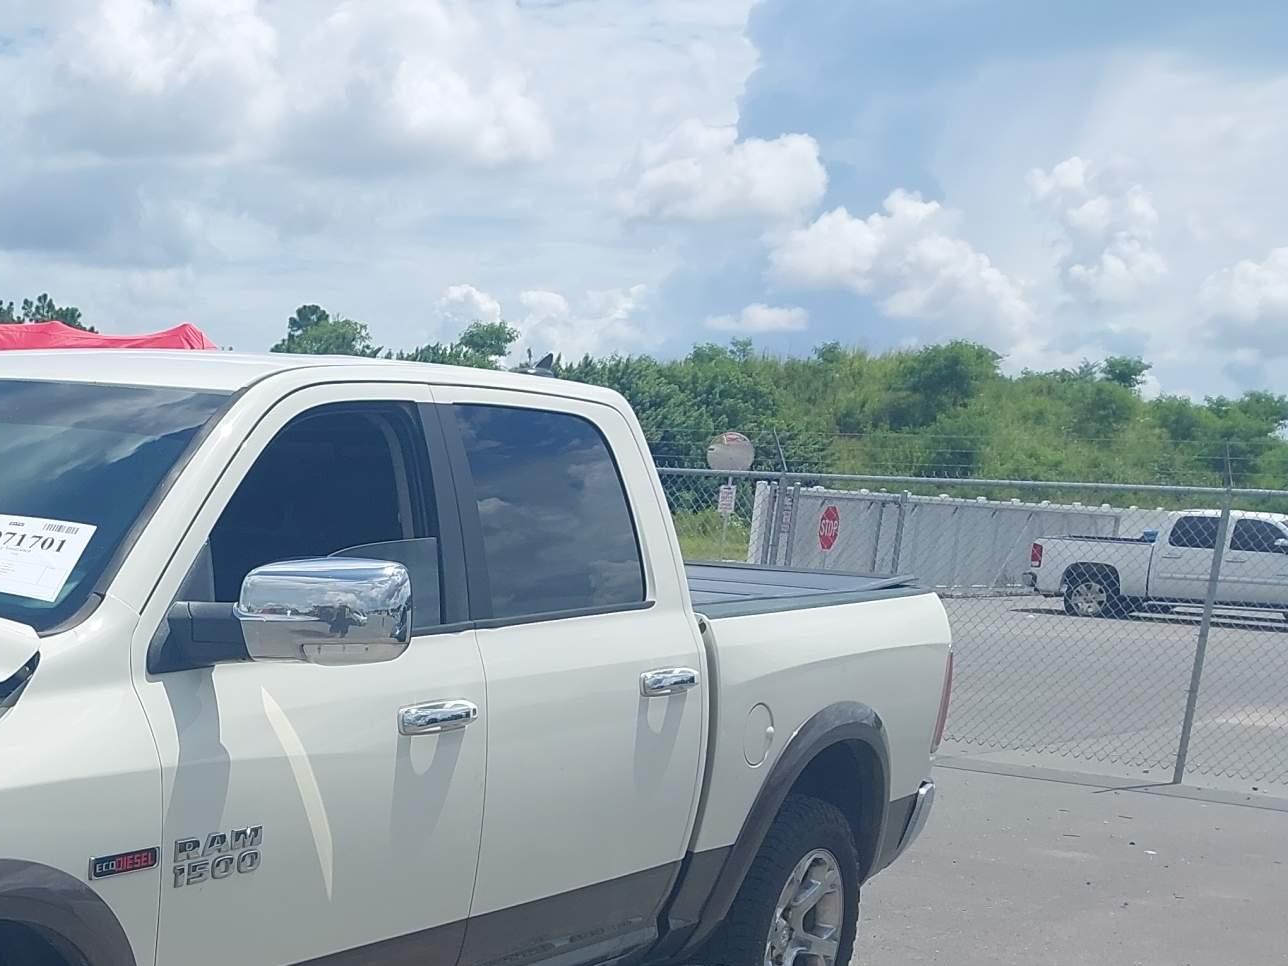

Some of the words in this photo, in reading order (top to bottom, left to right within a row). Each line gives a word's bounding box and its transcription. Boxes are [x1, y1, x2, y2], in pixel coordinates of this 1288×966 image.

[819, 519, 839, 537] STOP
[173, 825, 263, 863] RAM
[95, 851, 154, 874] ECODIESEL
[173, 849, 261, 888] 1500
